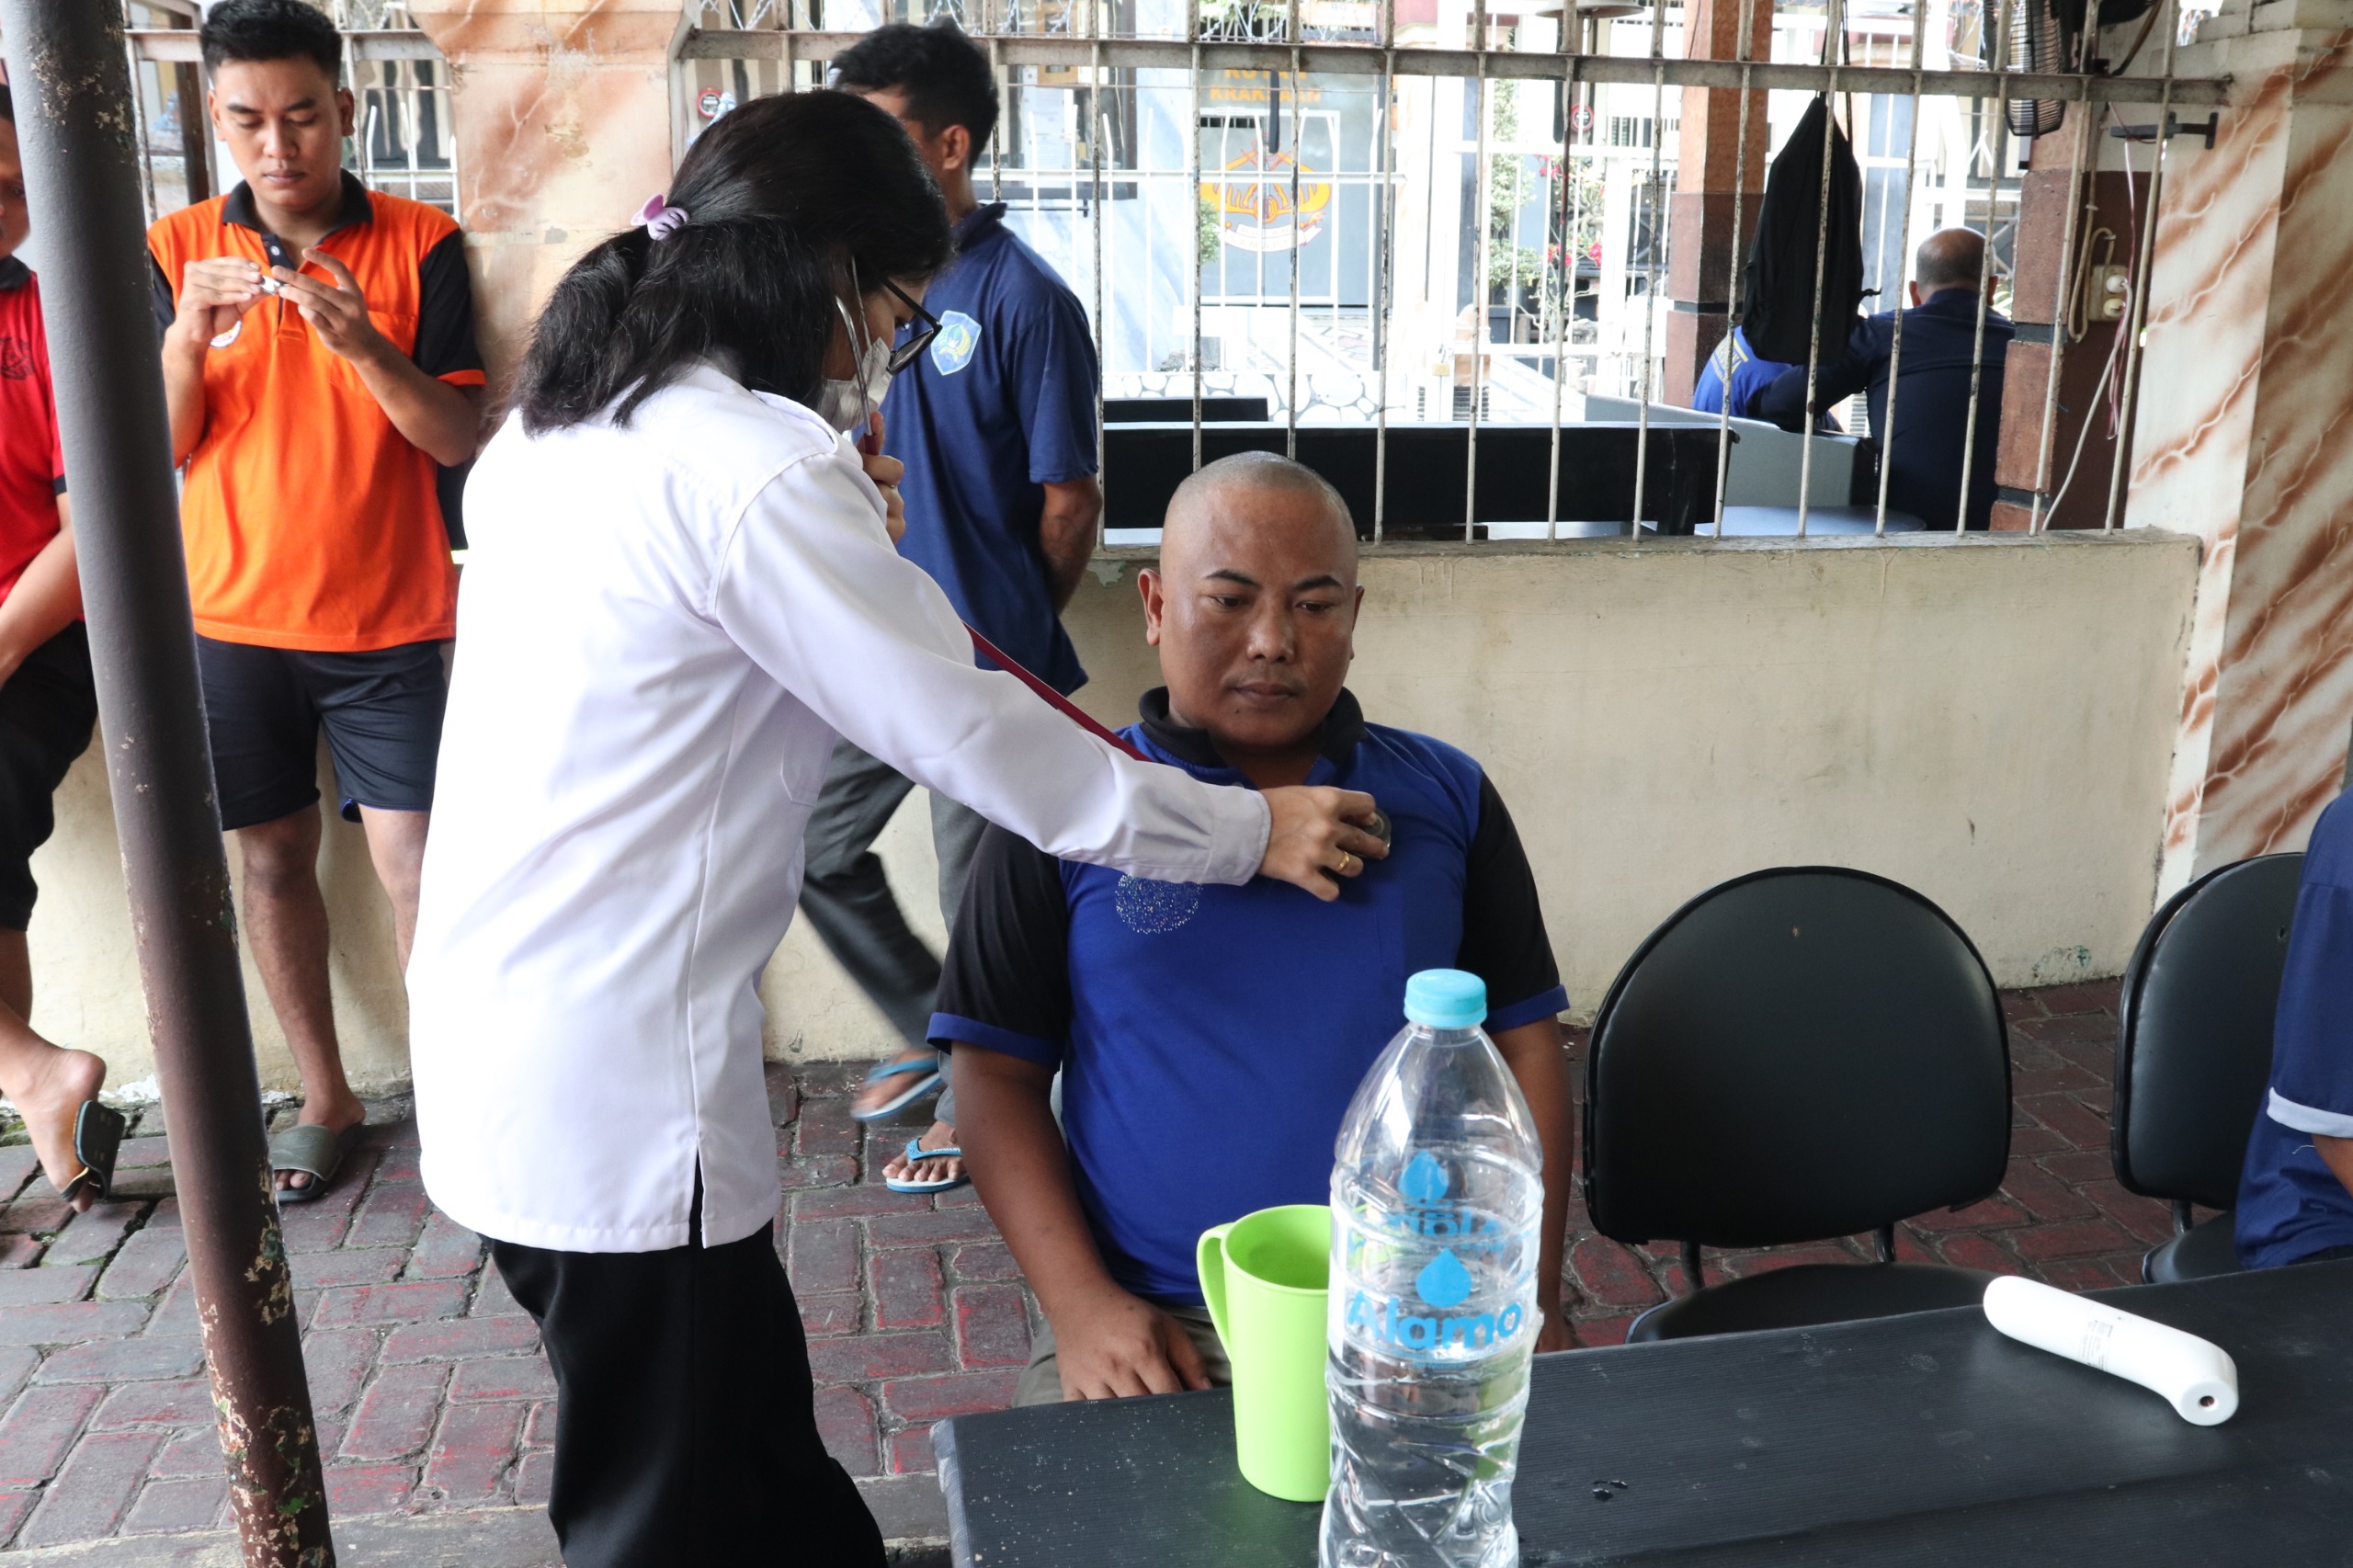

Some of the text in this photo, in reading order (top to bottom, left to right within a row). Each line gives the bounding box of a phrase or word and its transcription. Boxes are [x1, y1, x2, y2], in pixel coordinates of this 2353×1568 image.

[1224, 69, 1307, 80] RUT
[1209, 85, 1321, 102] KRAKAN
[1347, 1290, 1523, 1350] Alamo
